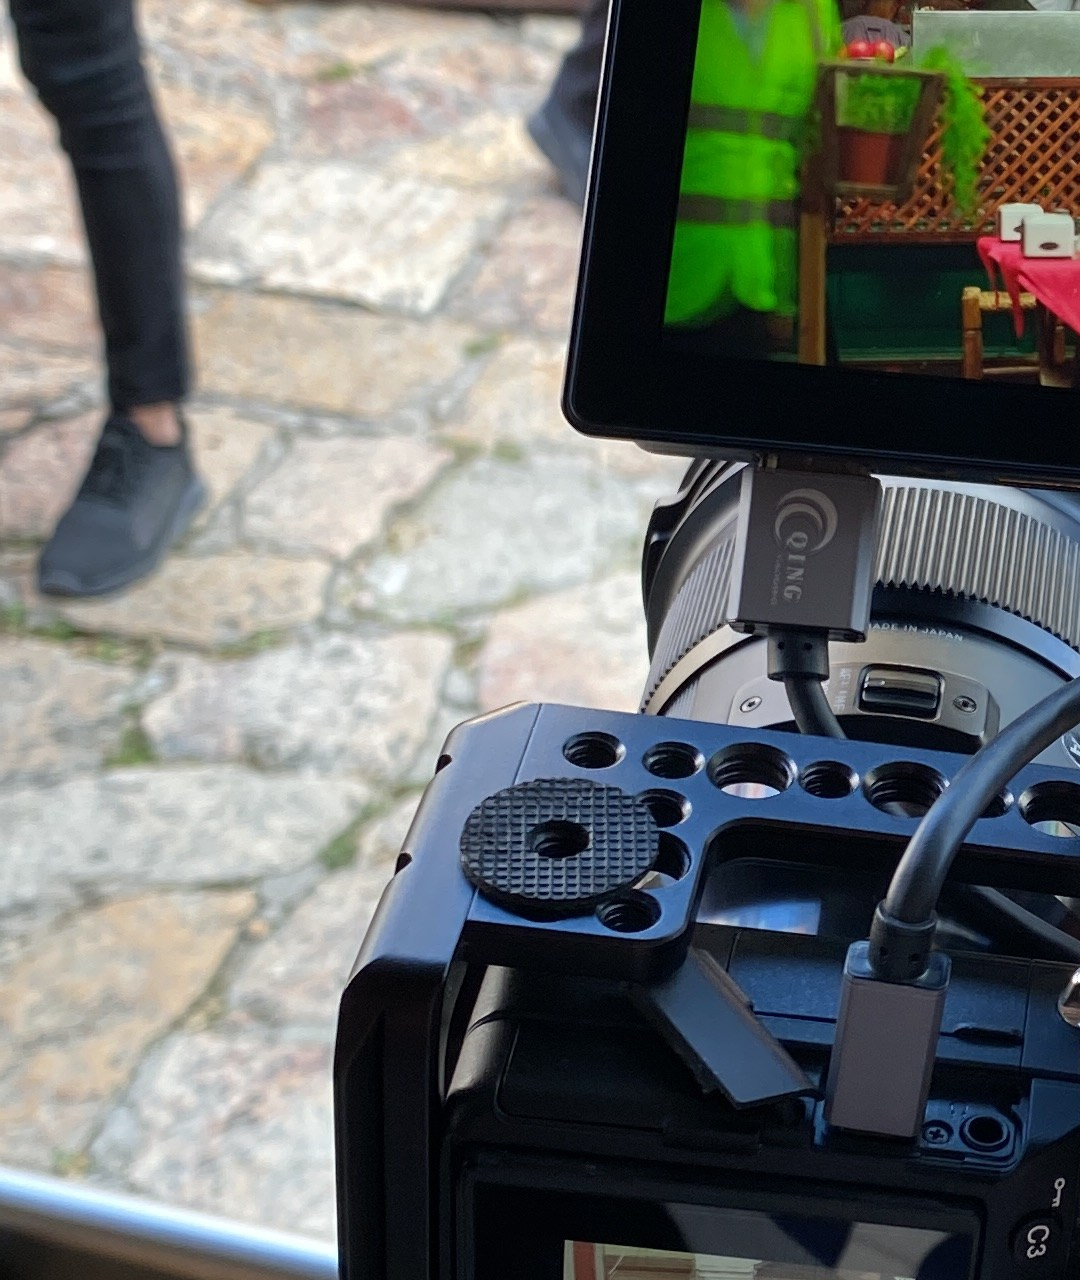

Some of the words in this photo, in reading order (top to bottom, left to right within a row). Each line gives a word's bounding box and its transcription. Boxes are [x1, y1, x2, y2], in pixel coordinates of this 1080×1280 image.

[783, 531, 809, 604] QING
[903, 624, 918, 633] IN
[922, 627, 964, 642] JAPAN
[1026, 1224, 1050, 1259] C3
